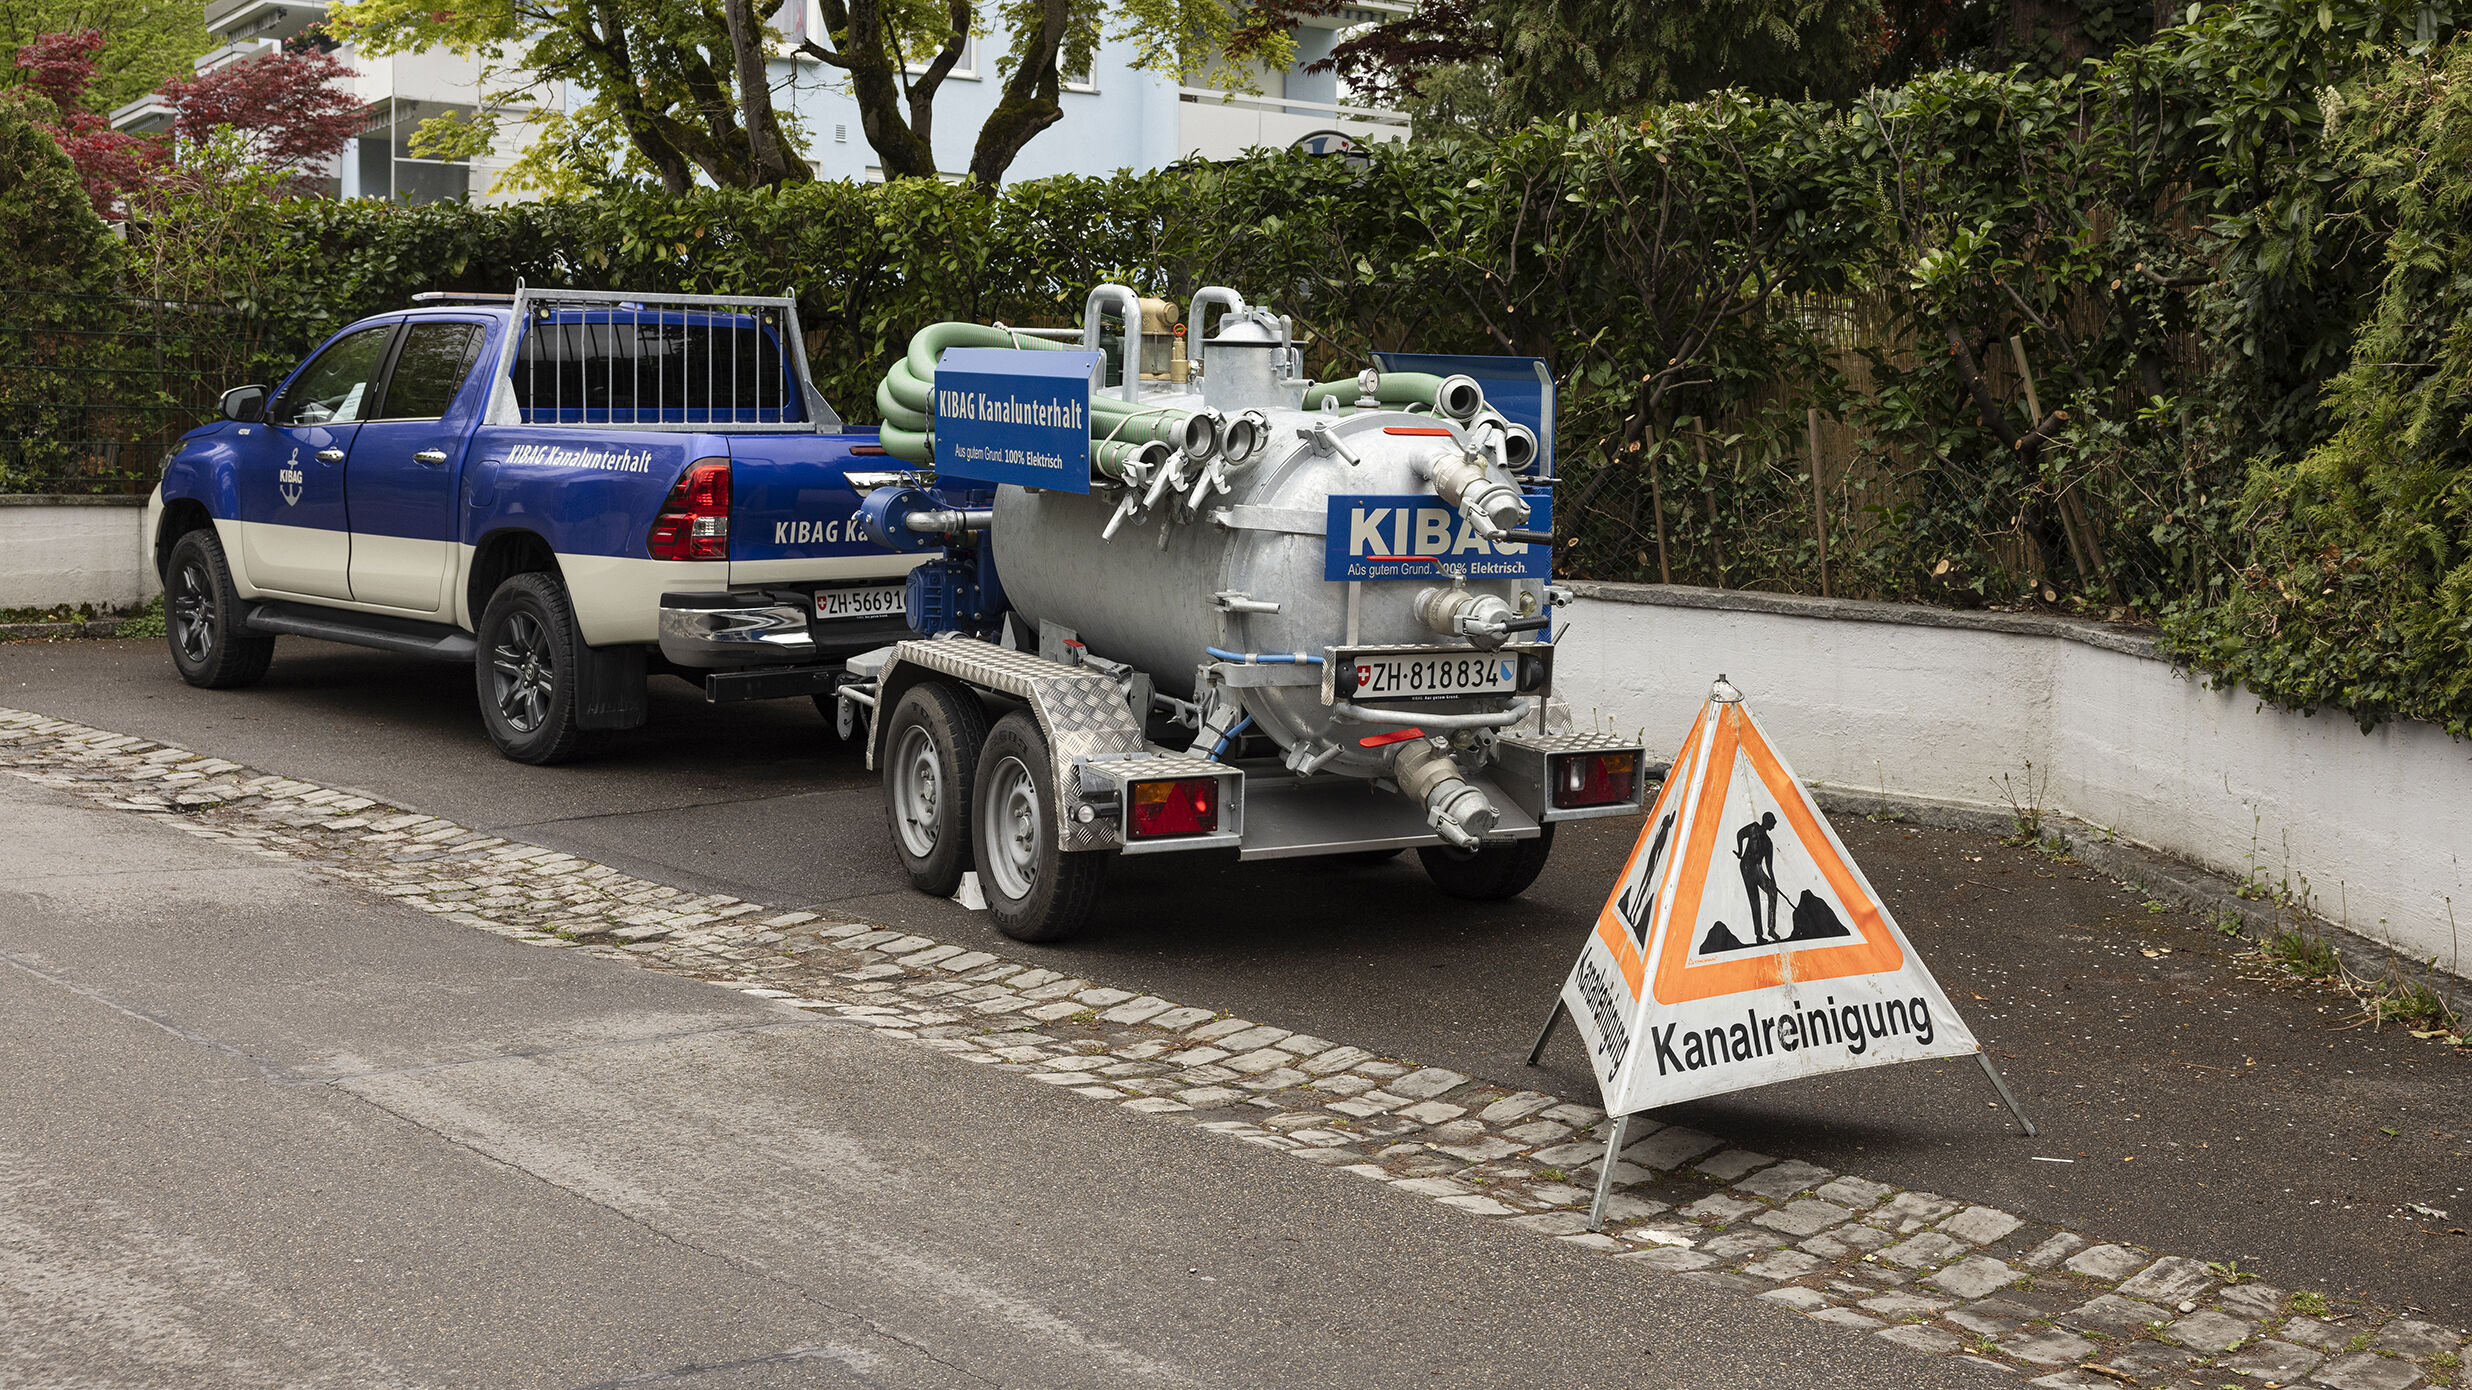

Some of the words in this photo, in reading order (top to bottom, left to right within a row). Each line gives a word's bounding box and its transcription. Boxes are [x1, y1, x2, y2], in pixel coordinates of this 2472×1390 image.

[939, 390, 975, 420] KIBAG
[978, 393, 1082, 430] Kanalunterhalt
[505, 444, 549, 465] KIBAG
[544, 446, 652, 473] Kanalunterhalt
[954, 443, 966, 458] Aus
[966, 446, 984, 462] gutem
[984, 446, 1003, 462] Grund.
[1004, 449, 1025, 465] 100%
[1026, 452, 1063, 470] Elektrisch
[279, 469, 303, 484] KIBAG
[774, 520, 839, 544] KIBAG
[1347, 563, 1367, 576] Aus
[1368, 564, 1399, 579] gutem
[1401, 563, 1432, 575] Grund.
[1470, 562, 1528, 574] Elektrisch.
[827, 590, 907, 614] ZH·56691
[1575, 946, 1630, 1083] Kanalreinigung
[1651, 995, 1935, 1077] Kanalreinigung
